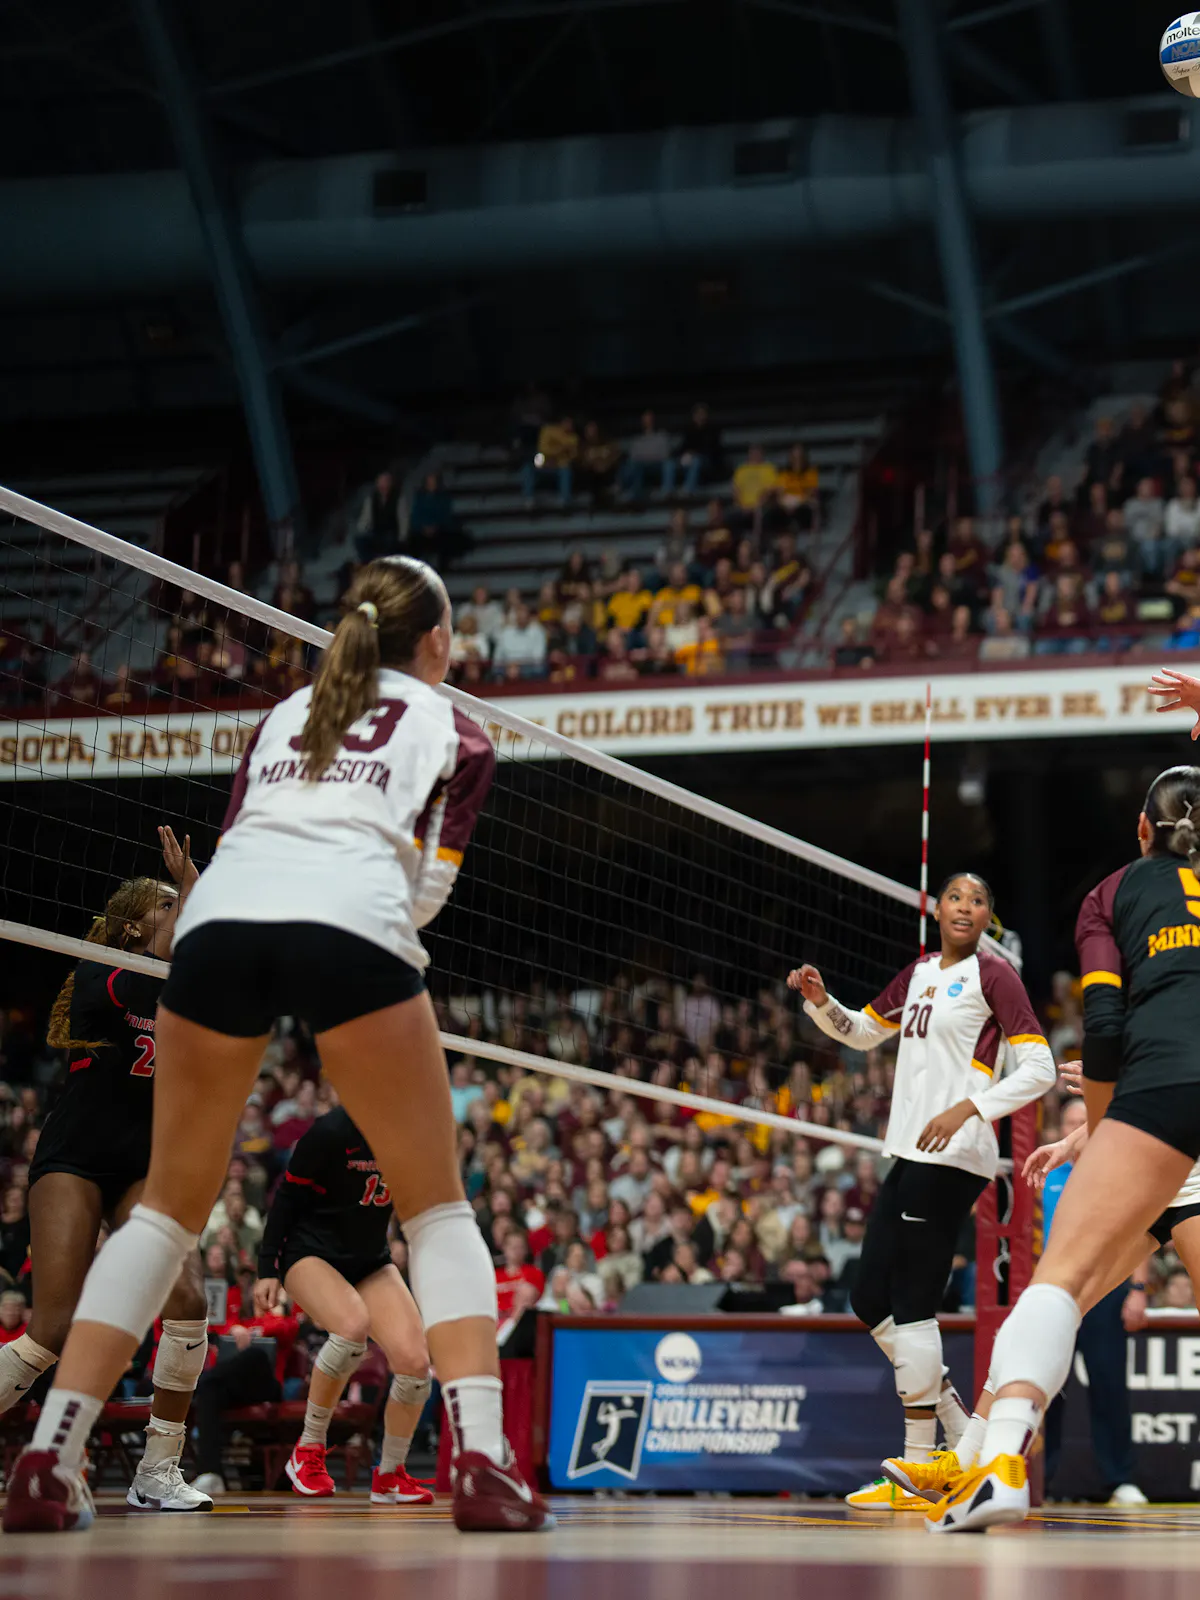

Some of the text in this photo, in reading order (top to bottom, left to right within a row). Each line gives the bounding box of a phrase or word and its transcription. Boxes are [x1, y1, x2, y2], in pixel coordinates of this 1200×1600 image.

[107, 728, 201, 762] HATS
[556, 706, 693, 740] COLORS
[706, 699, 804, 734] TRUE
[817, 704, 860, 726] WE
[870, 699, 965, 724] SHALL
[974, 694, 1050, 719] EVER
[903, 1003, 933, 1038] 20
[651, 1399, 801, 1432] VOLLEYBALL
[645, 1430, 780, 1454] CHAMPIONSHIP
